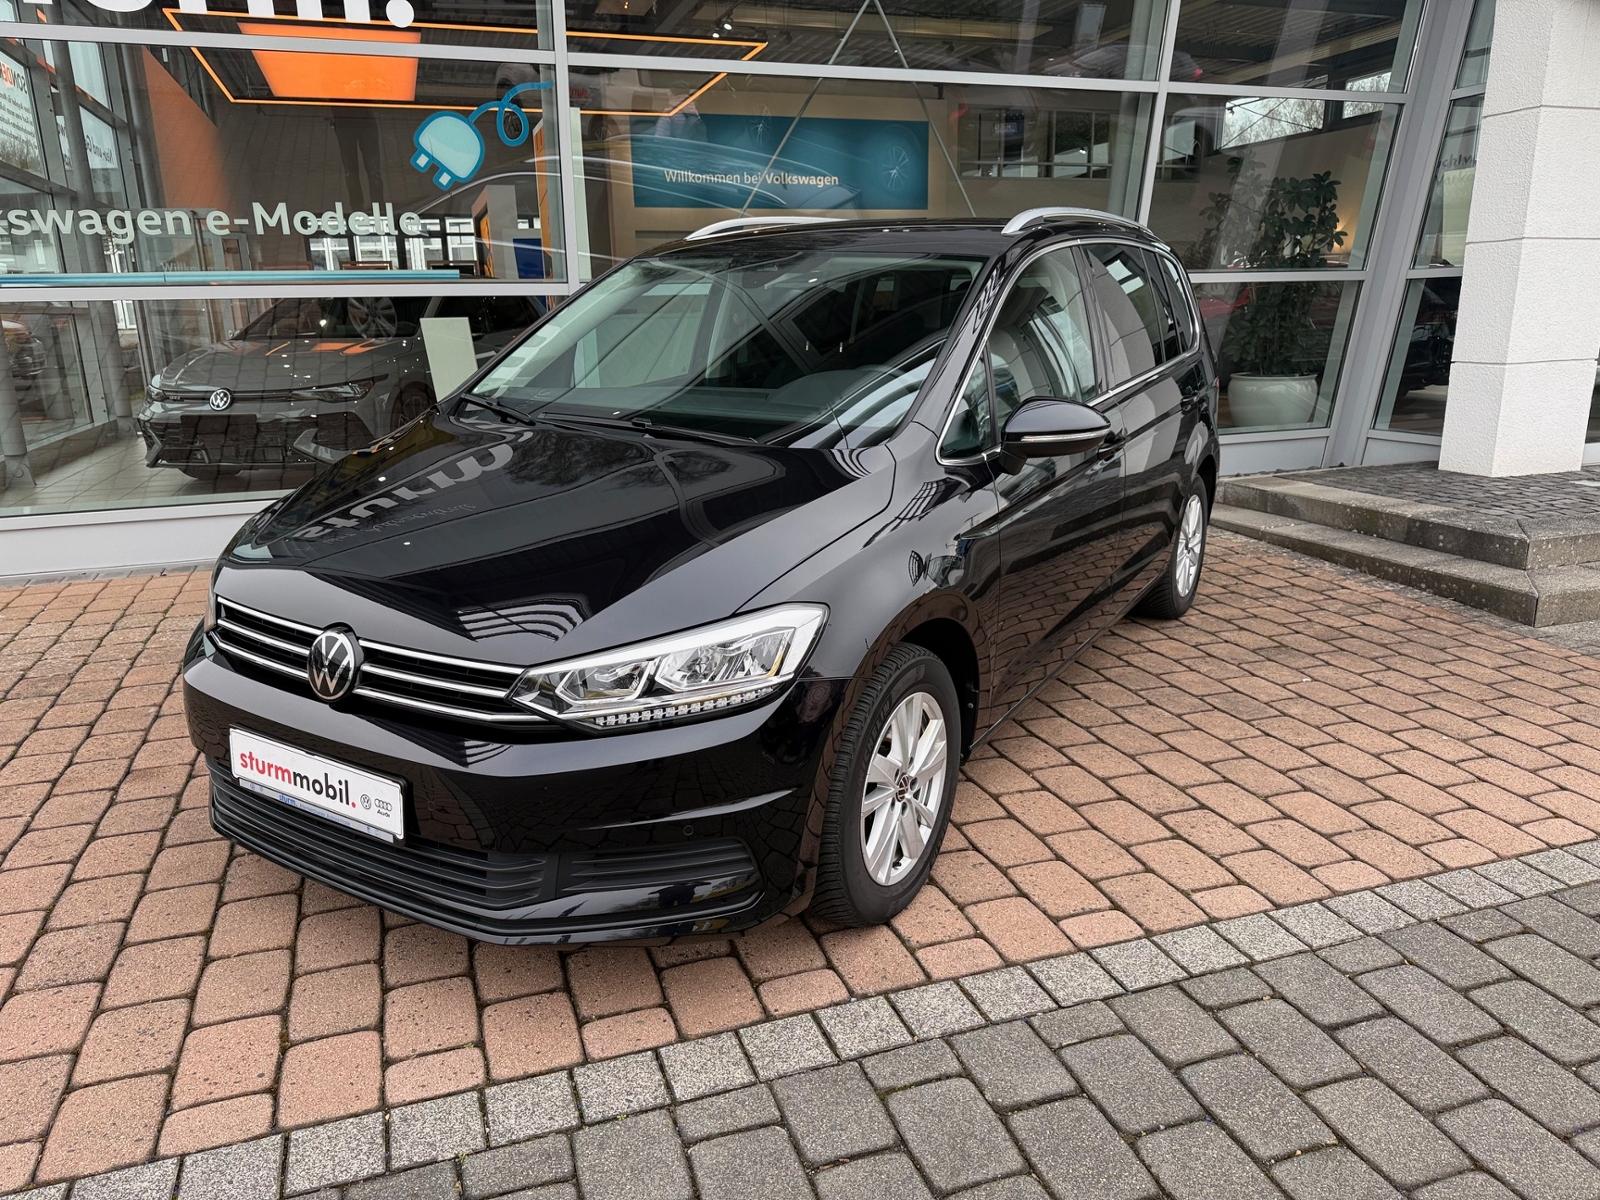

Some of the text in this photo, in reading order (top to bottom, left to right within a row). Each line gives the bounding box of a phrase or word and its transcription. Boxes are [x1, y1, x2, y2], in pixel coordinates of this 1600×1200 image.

[664, 169, 839, 188] Willkommen bei Volkswagen
[205, 201, 429, 237] e-Modelle
[309, 631, 355, 700] VW
[240, 751, 357, 809] sturmmobil.
